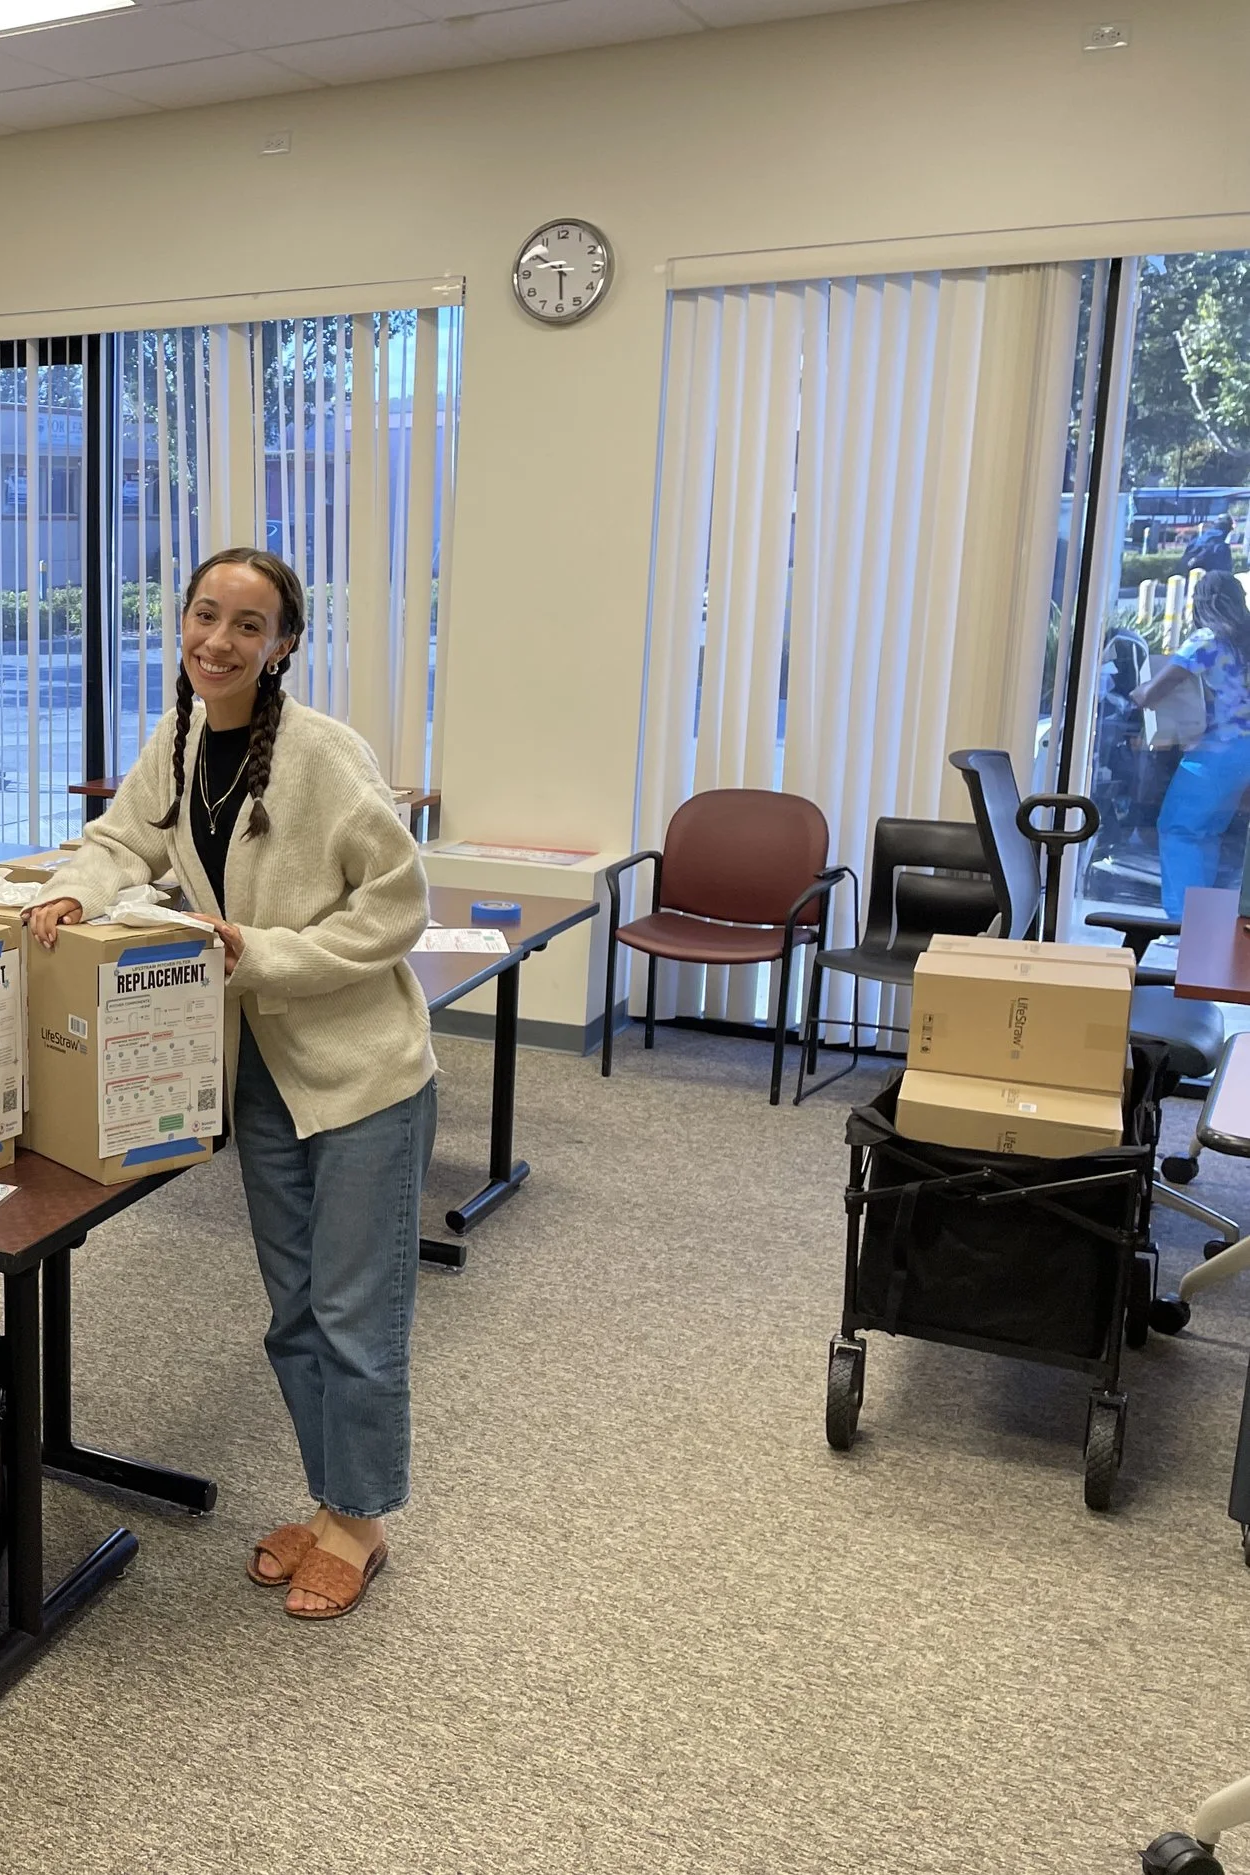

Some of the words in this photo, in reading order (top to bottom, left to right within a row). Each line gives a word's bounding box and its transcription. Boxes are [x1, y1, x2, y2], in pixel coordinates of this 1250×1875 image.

[558, 230, 569, 239] 12
[542, 237, 549, 248] 11
[587, 245, 597, 255] 2
[522, 270, 532, 280] 9
[586, 281, 595, 291] 4
[527, 288, 537, 298] 8
[539, 299, 548, 310] 7
[573, 296, 582, 307] 5
[555, 303, 565, 313] 6
[117, 964, 206, 994] REPLACEMENT
[1013, 997, 1029, 1046] LifeStraw
[41, 1027, 80, 1051] LifeStraw
